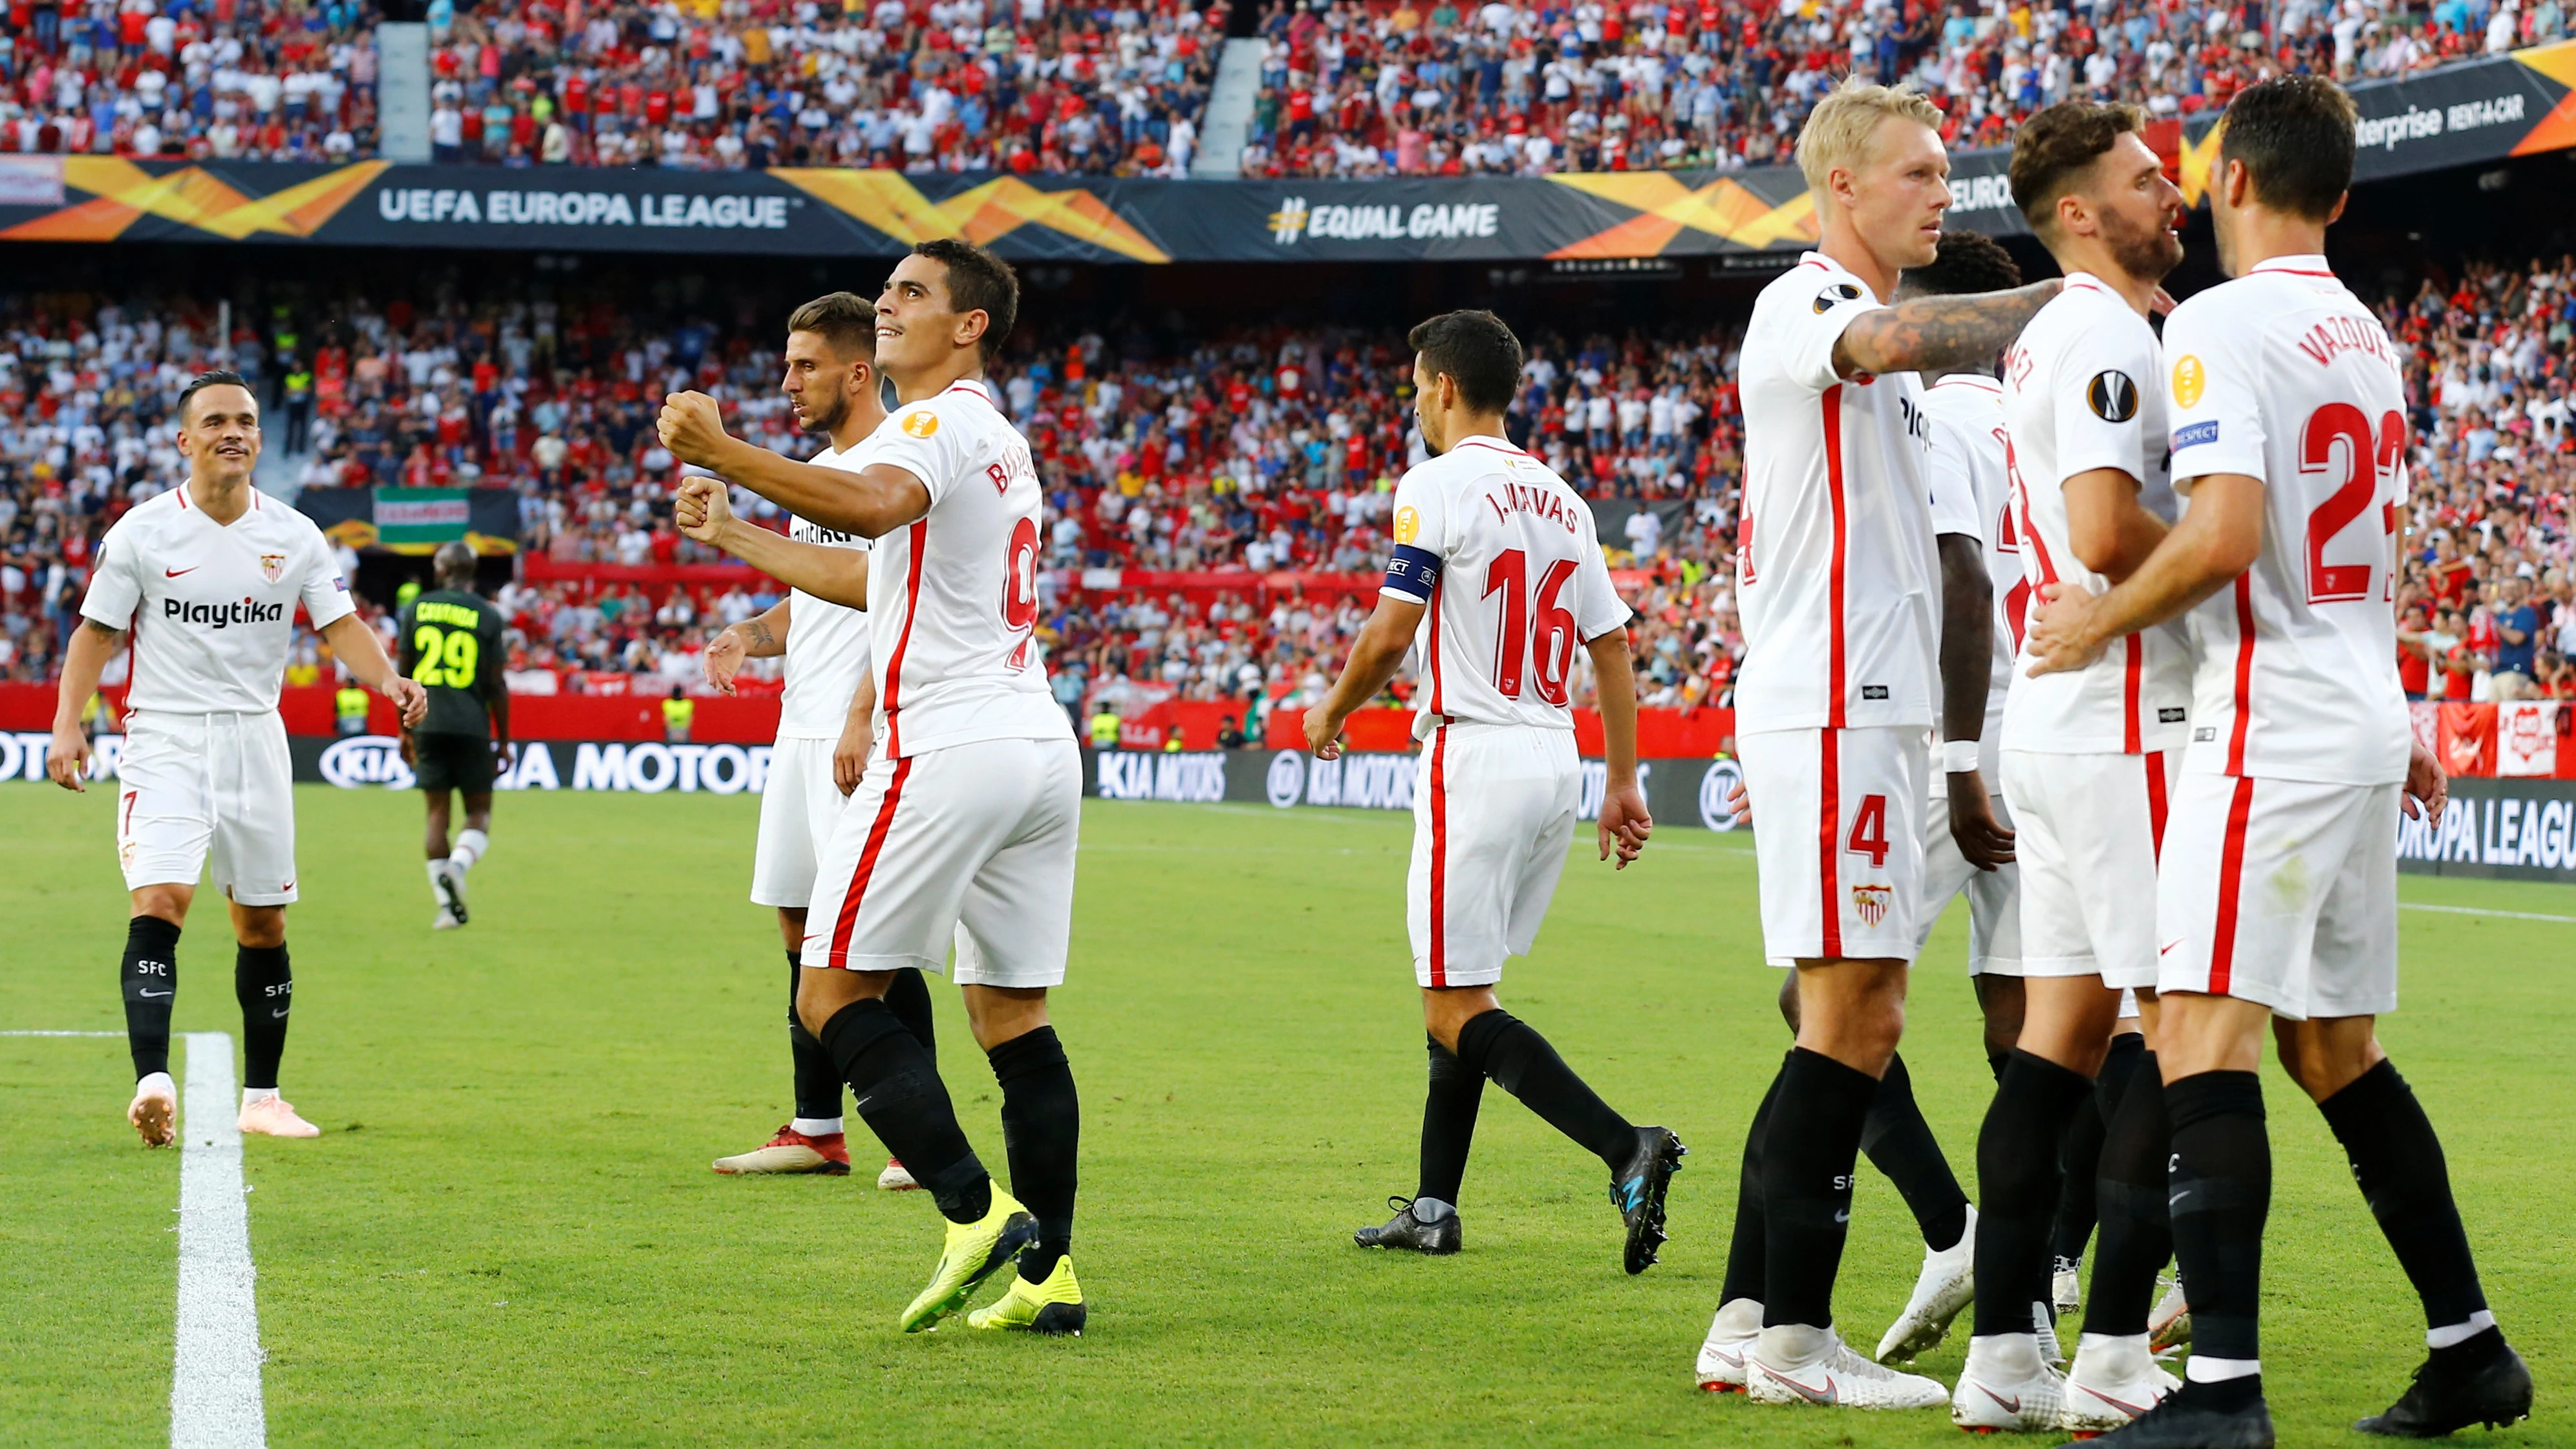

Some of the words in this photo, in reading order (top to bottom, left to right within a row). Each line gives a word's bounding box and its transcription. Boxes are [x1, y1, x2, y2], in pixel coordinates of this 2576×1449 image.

[2447, 94, 2525, 132] RENT-A-CAR
[379, 188, 480, 222] UEFA
[486, 190, 635, 226] EUROPA
[1266, 196, 1405, 244] #EQUAL
[1407, 204, 1498, 240] GAME
[1485, 481, 1579, 535] J.NAVAS
[165, 597, 283, 628] Playtika
[1002, 516, 1040, 672] 9
[1481, 548, 1579, 708] 16
[413, 625, 478, 689] 29
[123, 791, 137, 836] 7
[1845, 794, 1890, 868] 4
[138, 960, 167, 977] SFC
[265, 980, 292, 996] SFC
